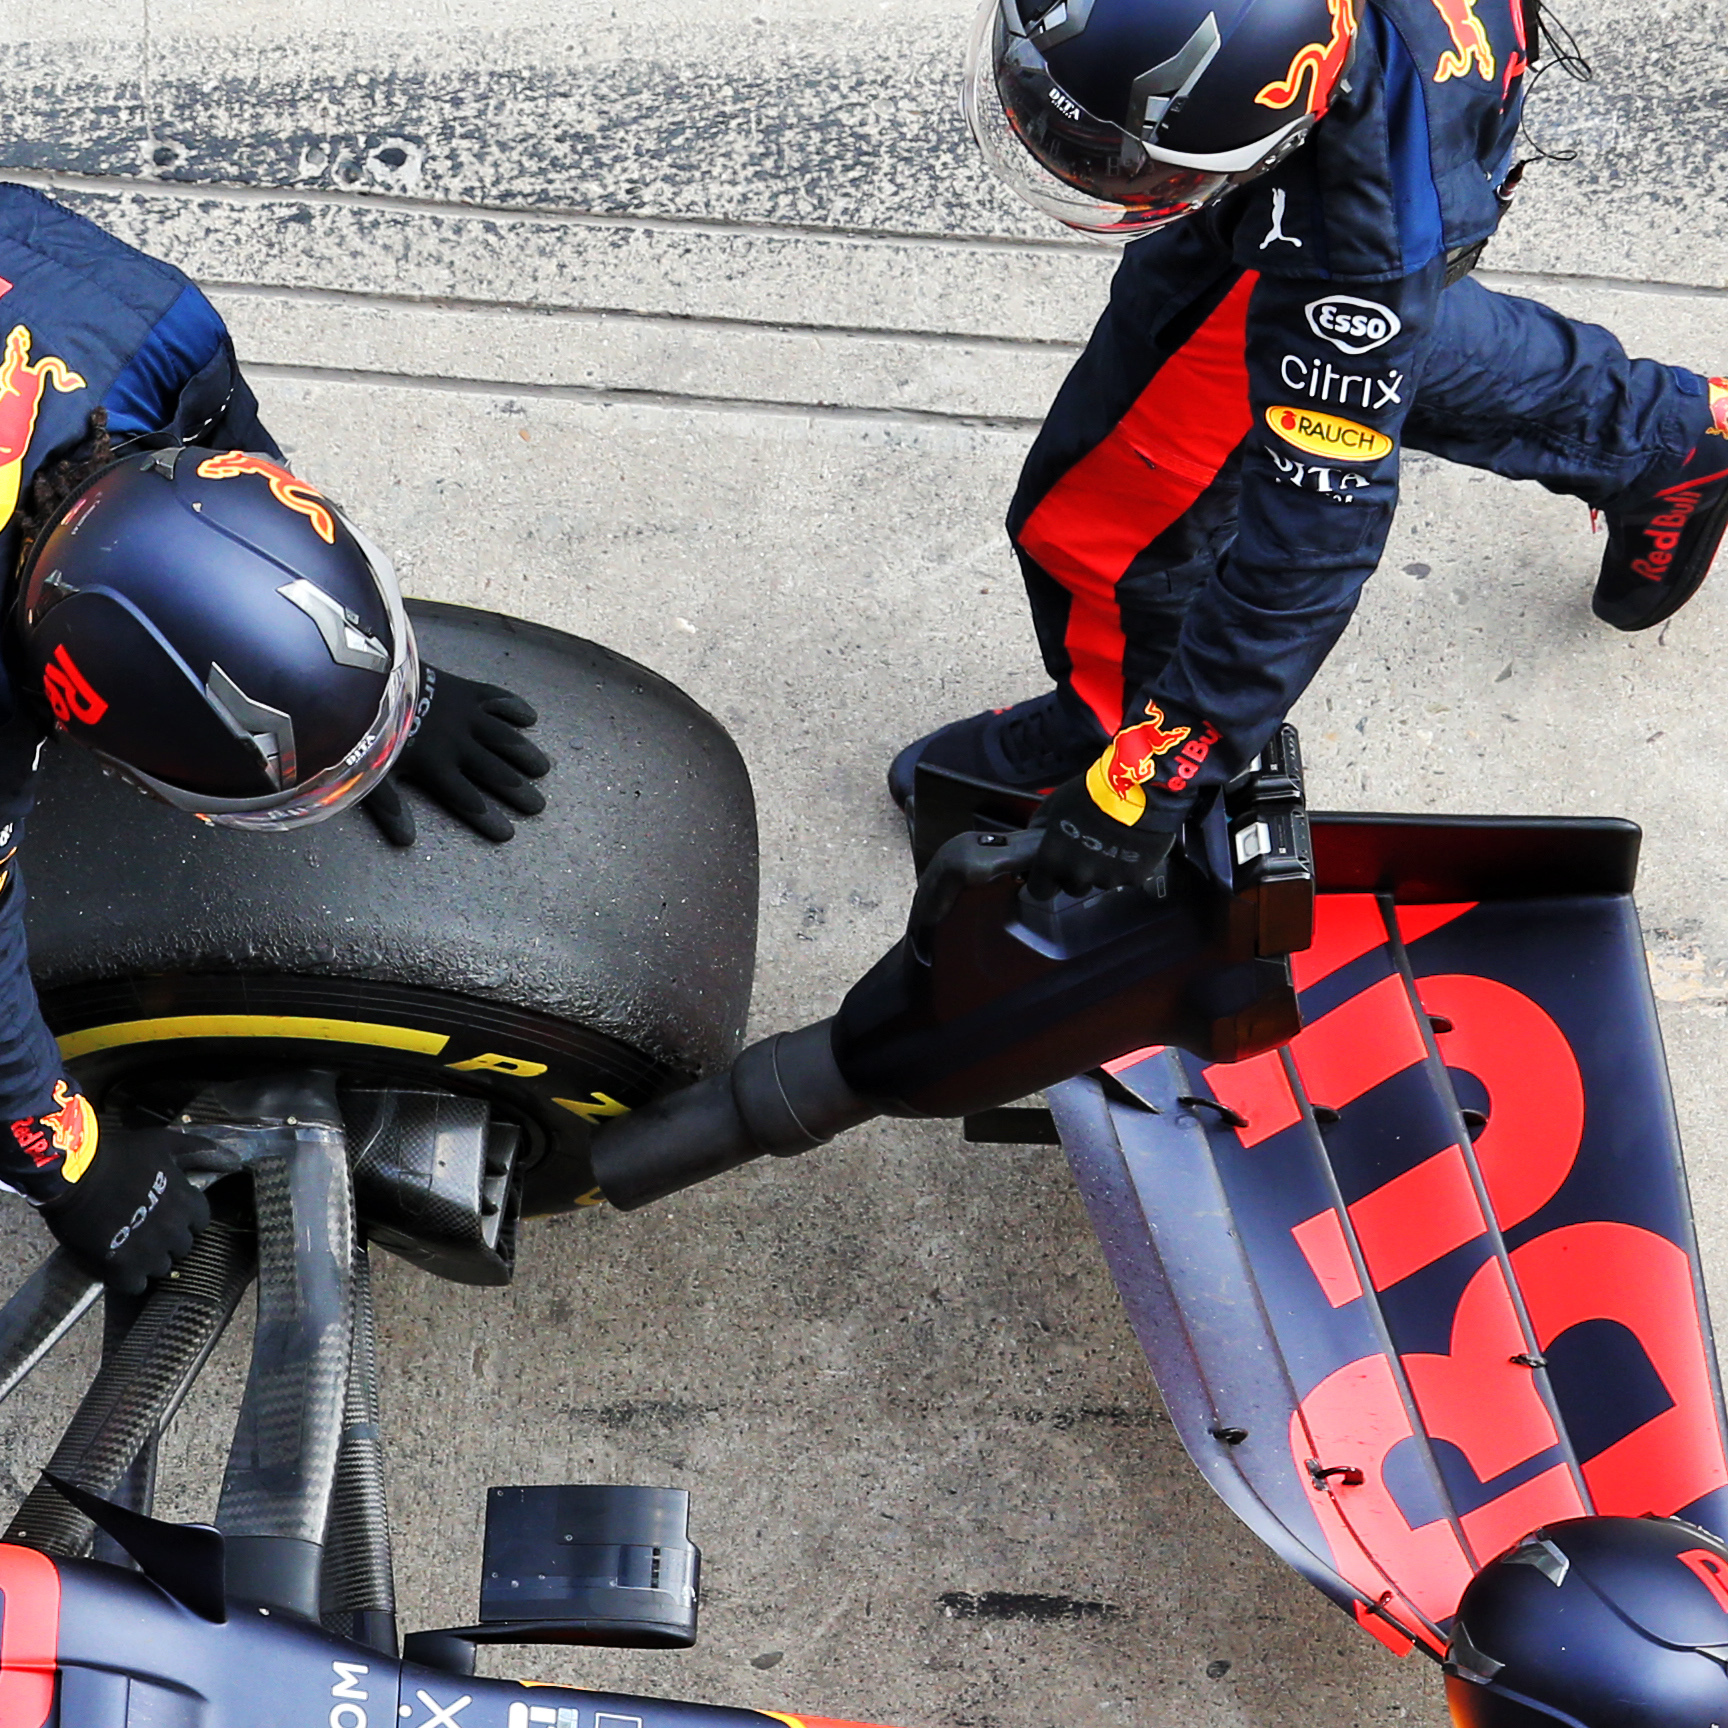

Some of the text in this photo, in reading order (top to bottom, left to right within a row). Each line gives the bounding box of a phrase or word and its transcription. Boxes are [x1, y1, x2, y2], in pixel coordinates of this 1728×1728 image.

[1048, 86, 1082, 121] DITA
[1318, 304, 1387, 340] Esso
[1297, 415, 1376, 451] RAUCH
[1630, 527, 1681, 582] Red
[109, 1170, 168, 1250] arco
